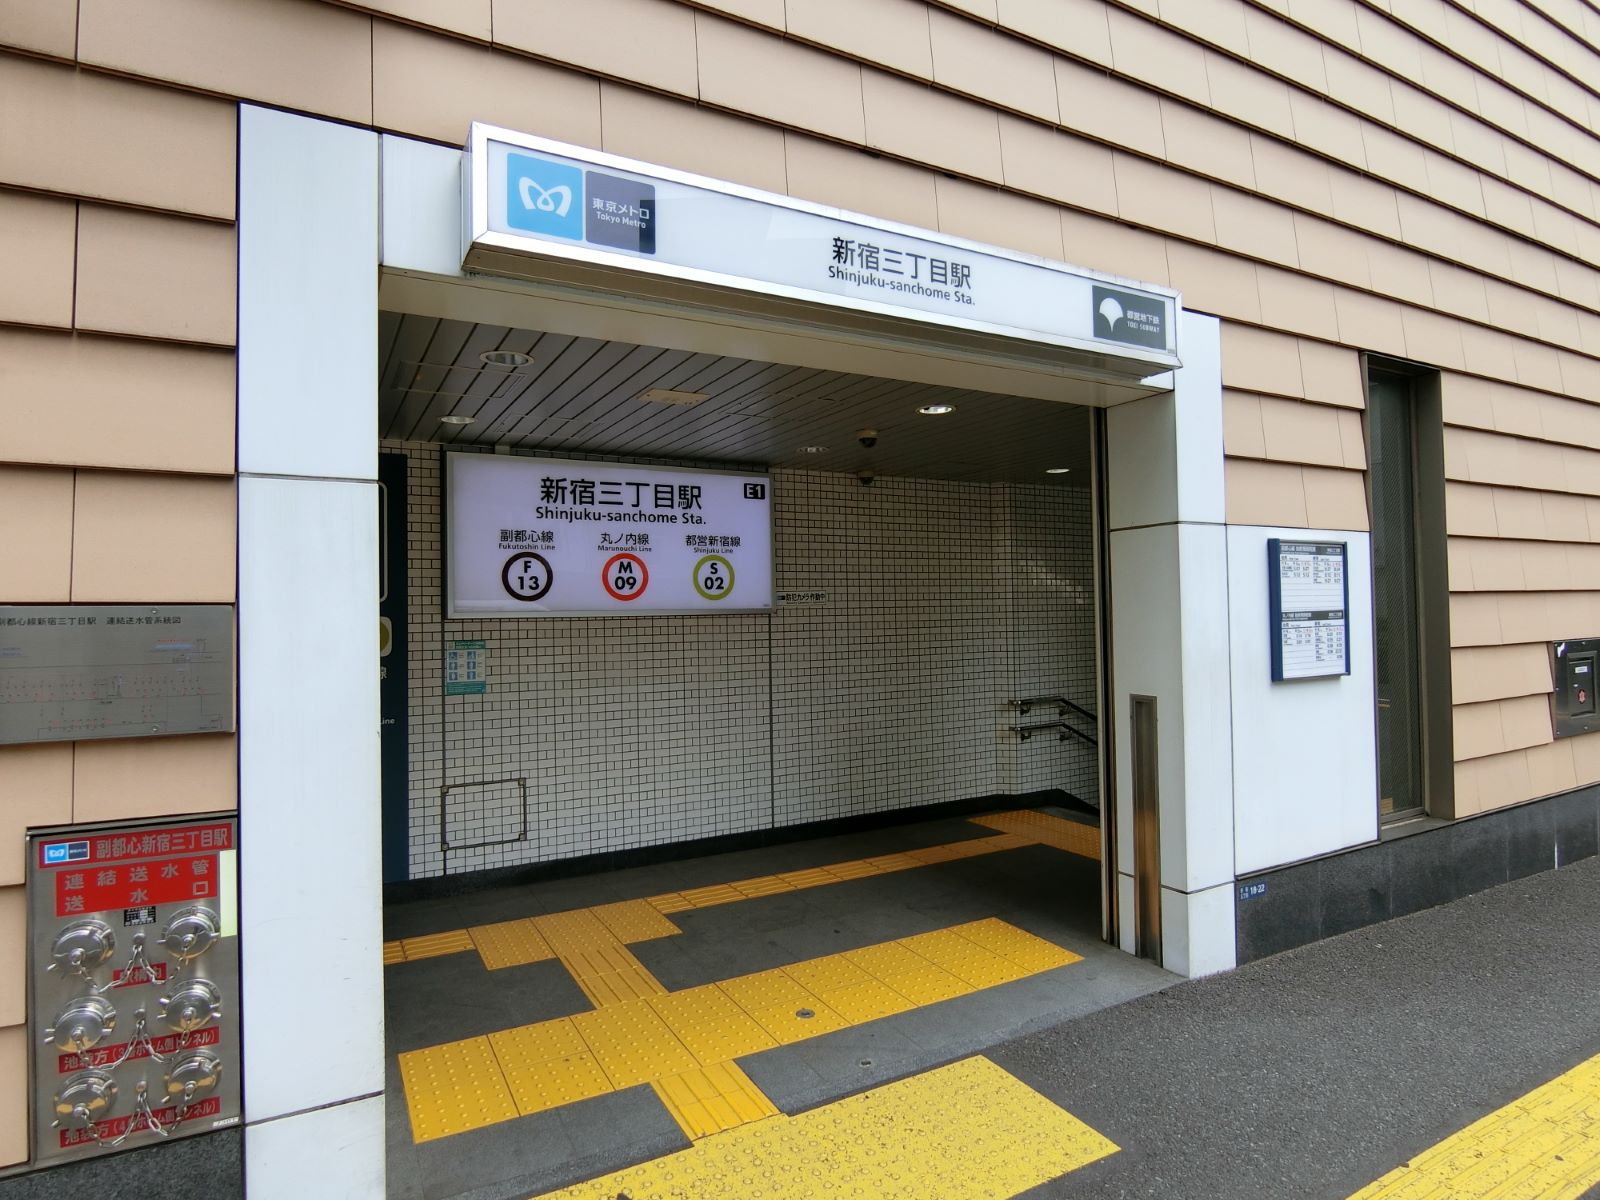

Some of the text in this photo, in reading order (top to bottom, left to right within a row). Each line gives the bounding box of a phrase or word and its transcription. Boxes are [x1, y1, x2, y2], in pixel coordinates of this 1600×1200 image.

[592, 198, 649, 219] 東京メトロ
[596, 211, 647, 229] Tokyo Metro
[832, 236, 971, 290] 新宿三丁目駅
[828, 265, 975, 306] Shinjuku-sanchome Sta.
[540, 476, 702, 510] 新宿三丁目駅
[746, 485, 762, 498] E1
[536, 506, 706, 525] Shinjuku-sanchome Sta.
[500, 529, 554, 543] 副都心線
[600, 532, 649, 546] 丸ノ内線
[685, 534, 741, 547] 都営新宿線
[498, 542, 556, 551] Fukutoshin Line
[693, 547, 720, 555] Shinjuku
[523, 560, 532, 573] F
[618, 561, 633, 574] M
[710, 562, 718, 575] S
[517, 576, 540, 590] 13
[614, 576, 637, 590] 09
[704, 576, 724, 590] 02
[96, 828, 228, 859] 副都心新宿三丁目駅
[64, 859, 210, 891] 連結送水管
